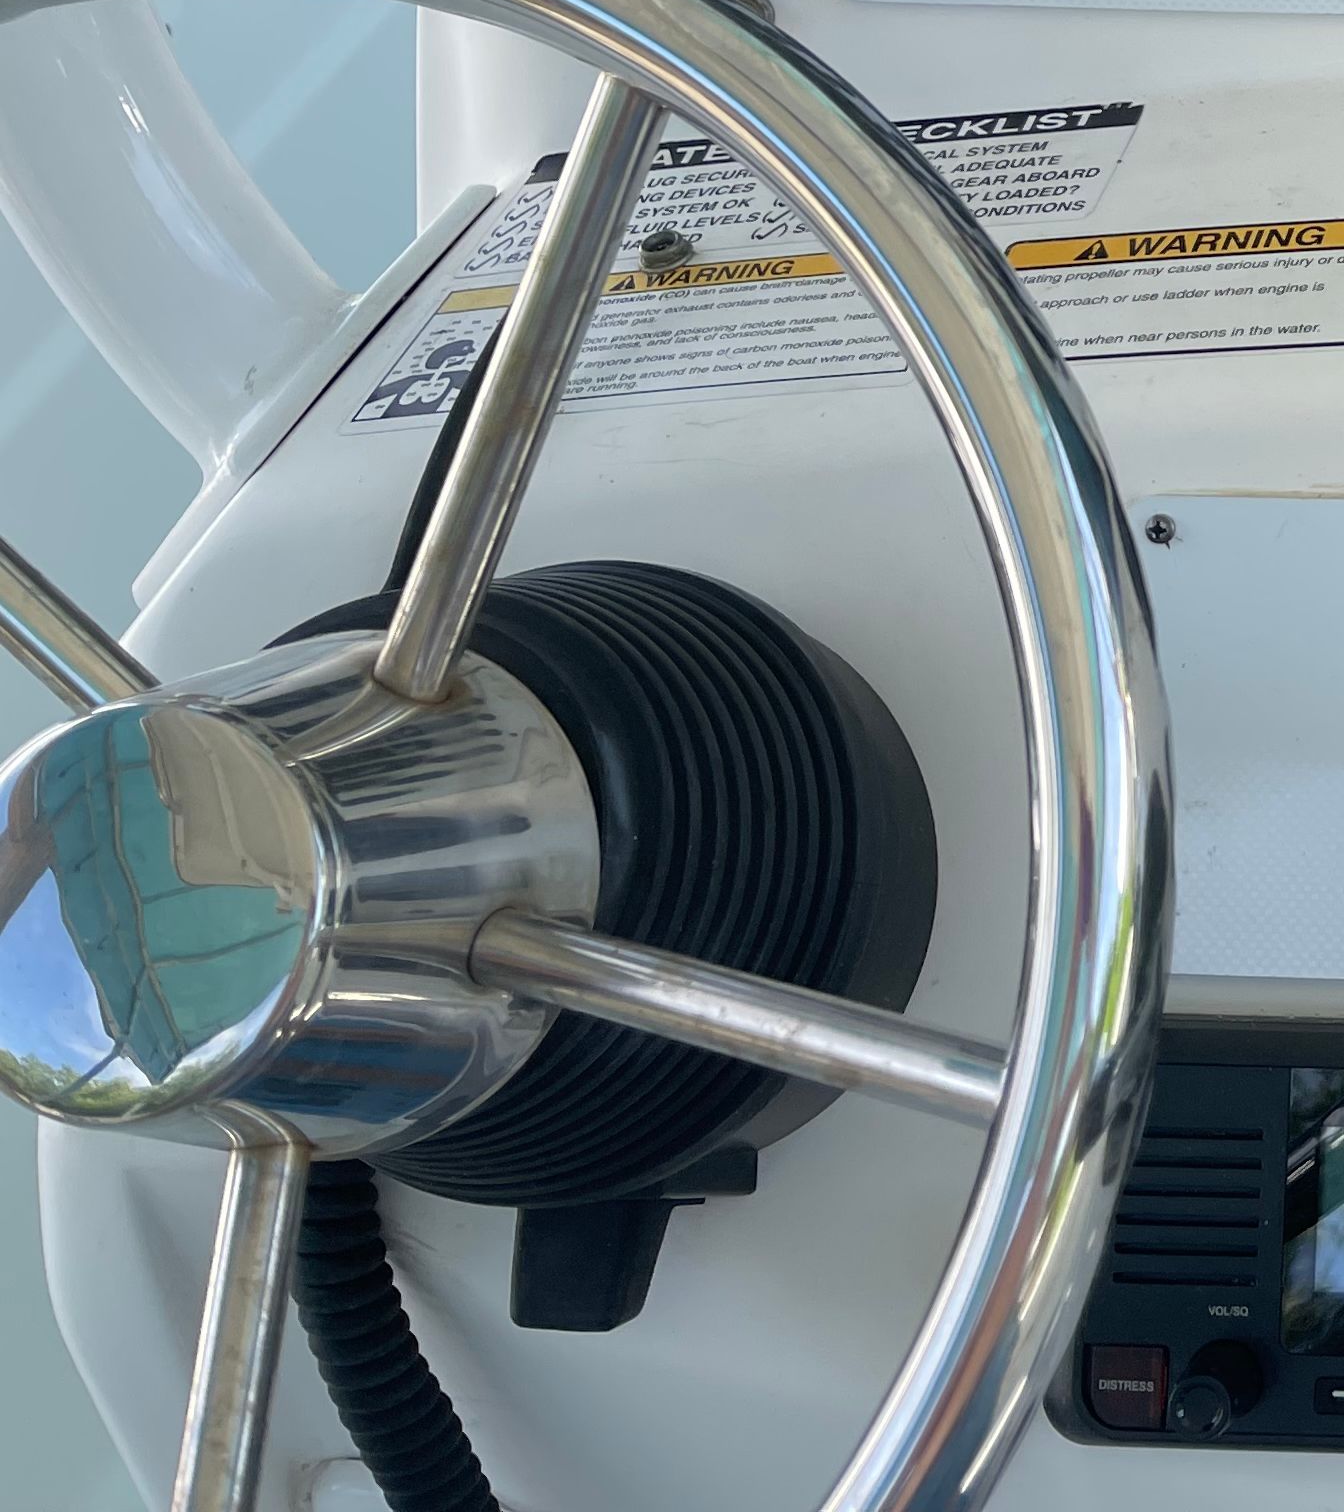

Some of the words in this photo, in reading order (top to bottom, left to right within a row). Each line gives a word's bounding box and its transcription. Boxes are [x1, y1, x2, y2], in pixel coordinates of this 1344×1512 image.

[965, 141, 1050, 157] SYSTEM
[950, 155, 1063, 173] ADEQUATE
[950, 174, 1008, 188] GEAR
[1012, 167, 1100, 184] ABOARD
[669, 183, 757, 200] DEVICES
[982, 185, 1080, 202] LOADED?
[635, 202, 719, 219] SYSTEM
[722, 197, 757, 209] OK
[681, 212, 761, 228] LEVELS
[1128, 225, 1327, 257] WARNING
[646, 260, 796, 288] WARNING
[1064, 268, 1130, 283] propeller
[1133, 266, 1164, 276] may
[1167, 262, 1212, 274] cause
[1215, 259, 1268, 271] serious
[1273, 257, 1313, 270] injury
[1318, 256, 1334, 264] or
[659, 289, 690, 301] (CO)
[693, 288, 716, 297] can
[794, 276, 847, 288] damage
[1040, 295, 1108, 310] approach
[1112, 294, 1129, 303] or
[1132, 292, 1158, 301] use
[1162, 286, 1210, 300] ladder
[1214, 283, 1253, 297] when
[1257, 283, 1309, 295] engine
[1312, 282, 1325, 292] is
[601, 309, 662, 321] generator
[664, 302, 714, 314] exhaust
[830, 290, 855, 299] and
[673, 324, 737, 338] poisoning
[740, 320, 787, 330] include
[1083, 334, 1124, 346] when
[1127, 333, 1161, 343] near
[1165, 328, 1227, 344] persons
[1230, 327, 1244, 337] in
[1249, 325, 1272, 336] the
[1277, 323, 1321, 335] water.
[647, 338, 671, 347] and
[674, 335, 700, 344] lack
[703, 333, 716, 341] of
[584, 356, 631, 369] anyone
[634, 354, 676, 364] shows
[679, 351, 713, 361] signs
[717, 347, 730, 356] of
[733, 344, 777, 354] carbon
[780, 338, 843, 351] monoxide
[596, 374, 617, 383] will
[619, 373, 636, 381] be
[640, 367, 686, 379] around
[688, 366, 709, 374] the
[712, 361, 744, 373] back
[747, 361, 761, 370] of
[763, 359, 784, 368] the
[787, 355, 817, 366] boat
[820, 354, 855, 363] when
[587, 381, 638, 392] running.
[1207, 1304, 1249, 1319] VOL/SQ
[1098, 1379, 1155, 1394] DISTRESS
